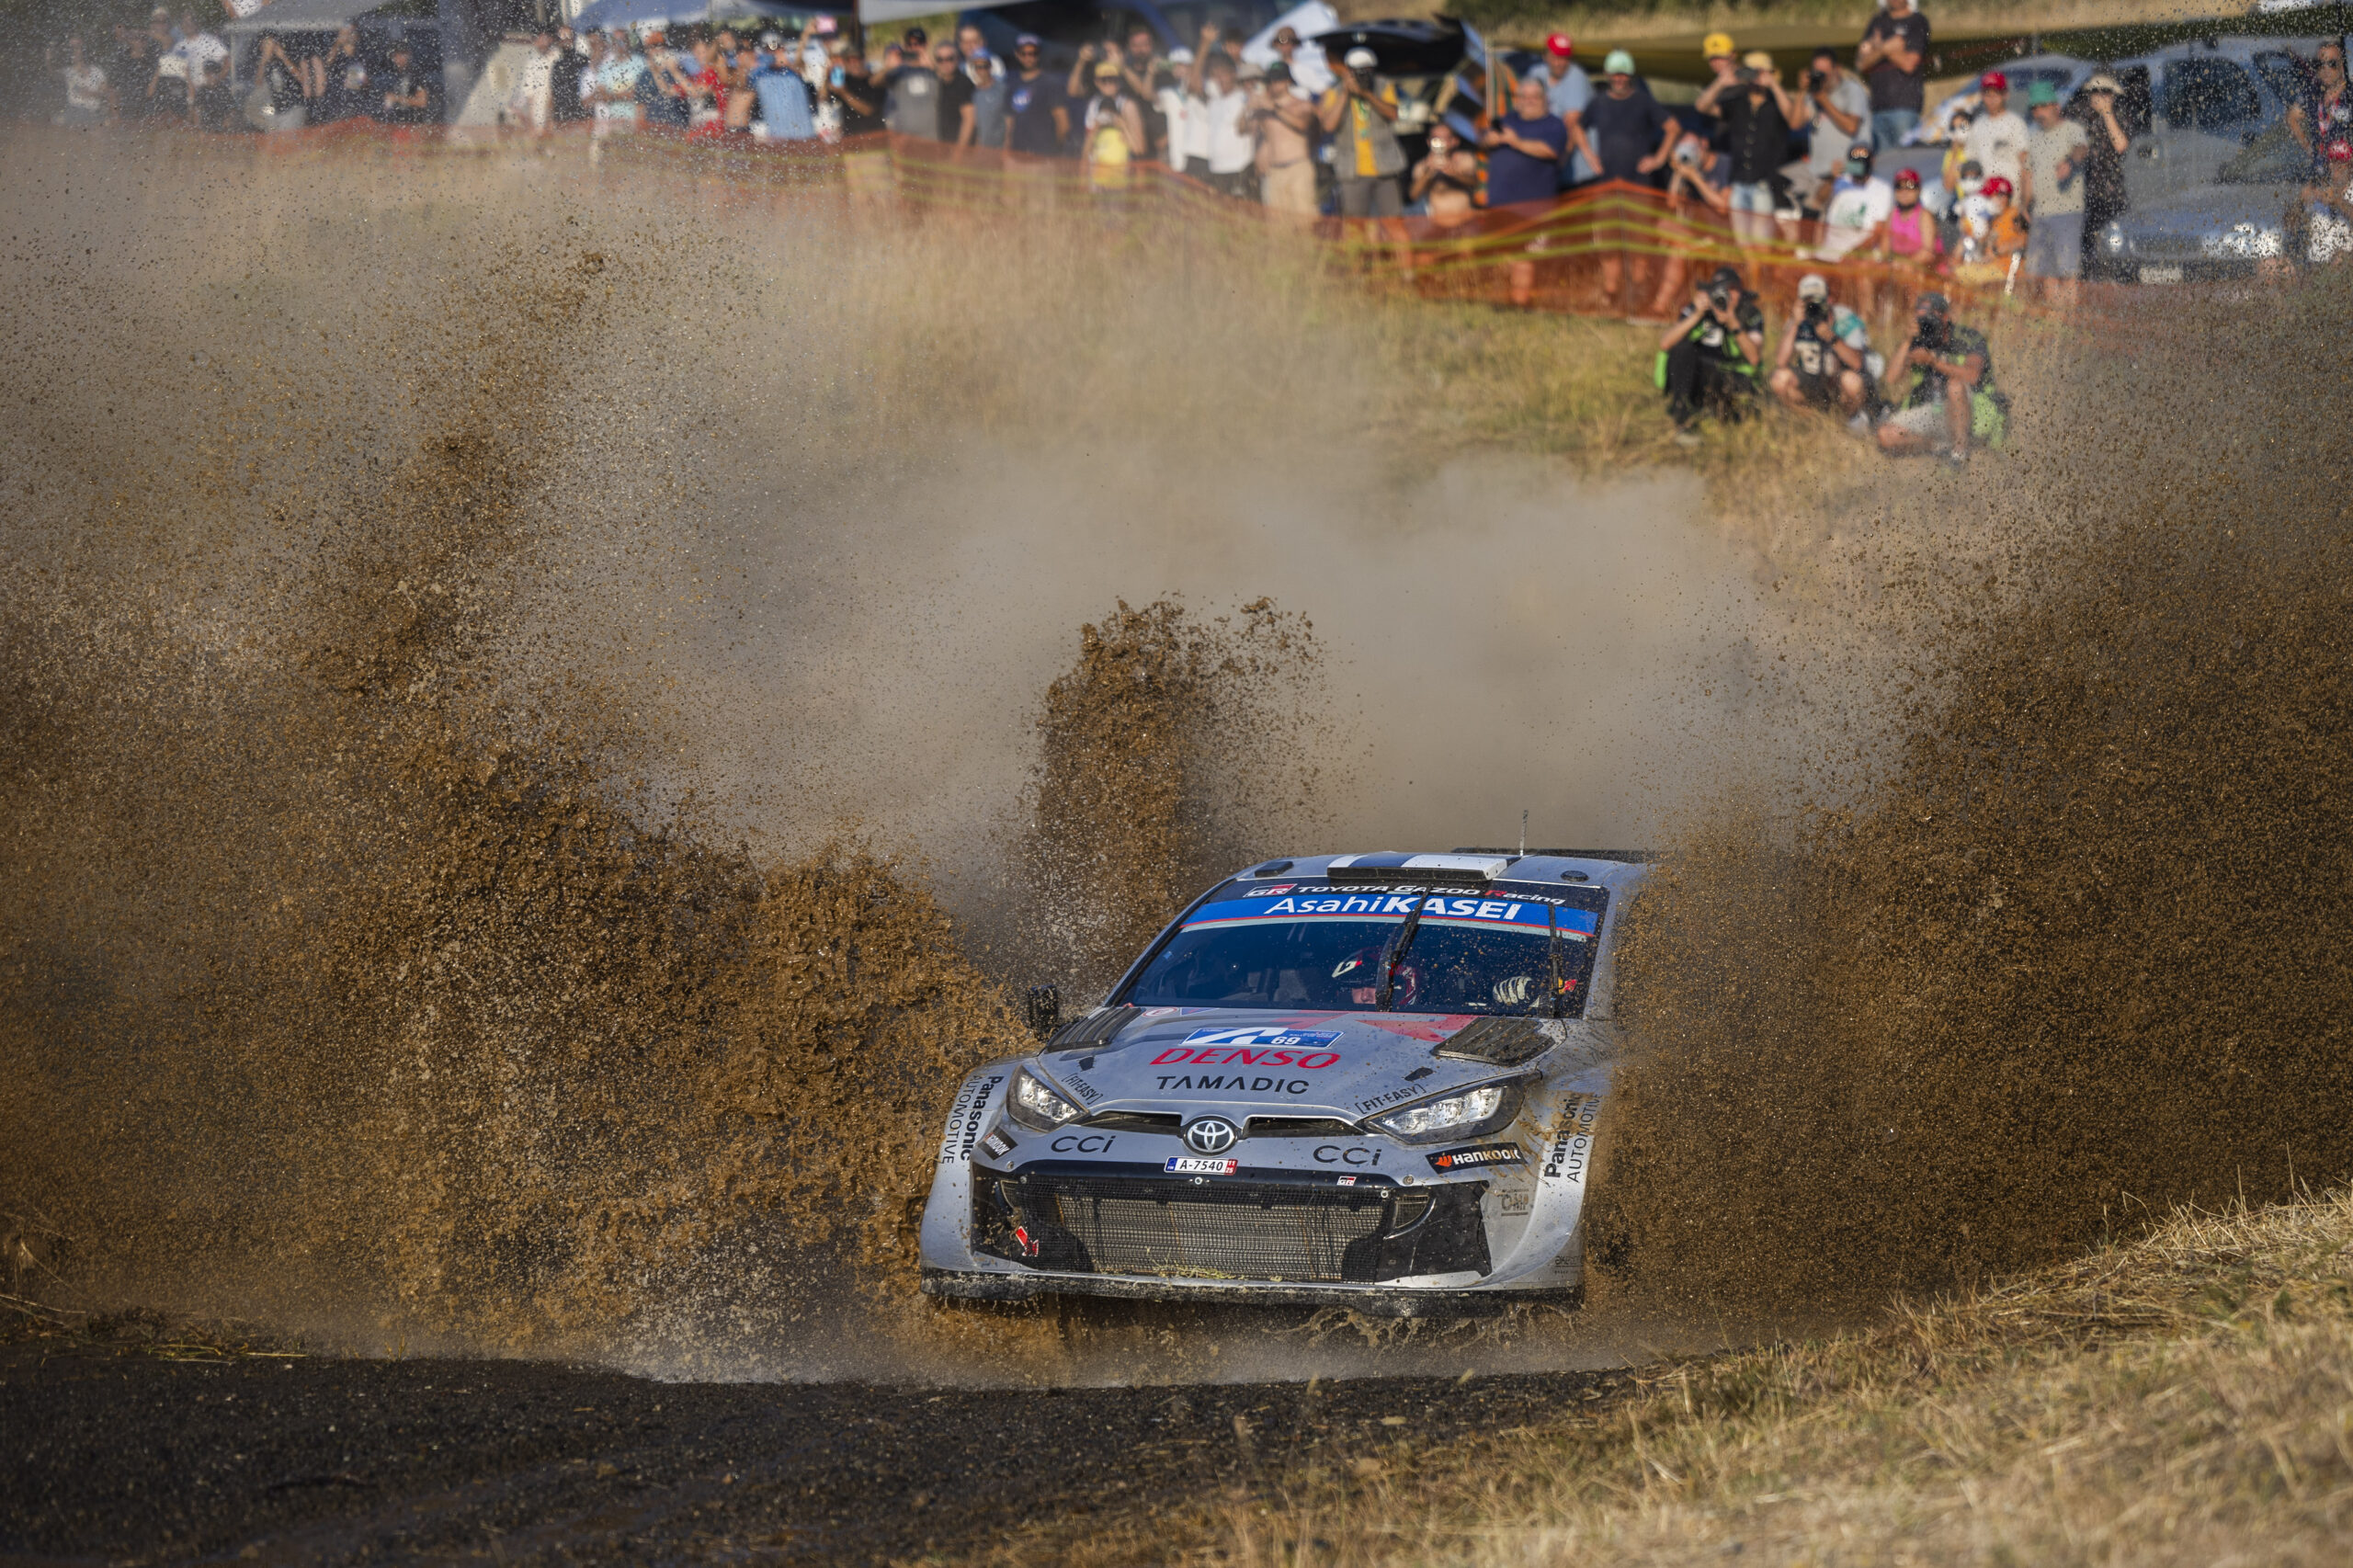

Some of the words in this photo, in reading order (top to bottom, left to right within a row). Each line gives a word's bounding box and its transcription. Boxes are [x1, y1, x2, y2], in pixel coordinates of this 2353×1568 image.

[1298, 885, 1390, 893] TOYOTA
[1394, 885, 1481, 895] GAZOO
[1484, 890, 1566, 905] Racing
[1270, 1036, 1302, 1045] 69
[1149, 1048, 1341, 1070] DENSO
[1156, 1075, 1309, 1095] TAMADIC
[941, 1075, 983, 1165] AUTOMOTIVE
[961, 1076, 1005, 1161] Panasonic
[1179, 1160, 1223, 1171] A-7540
